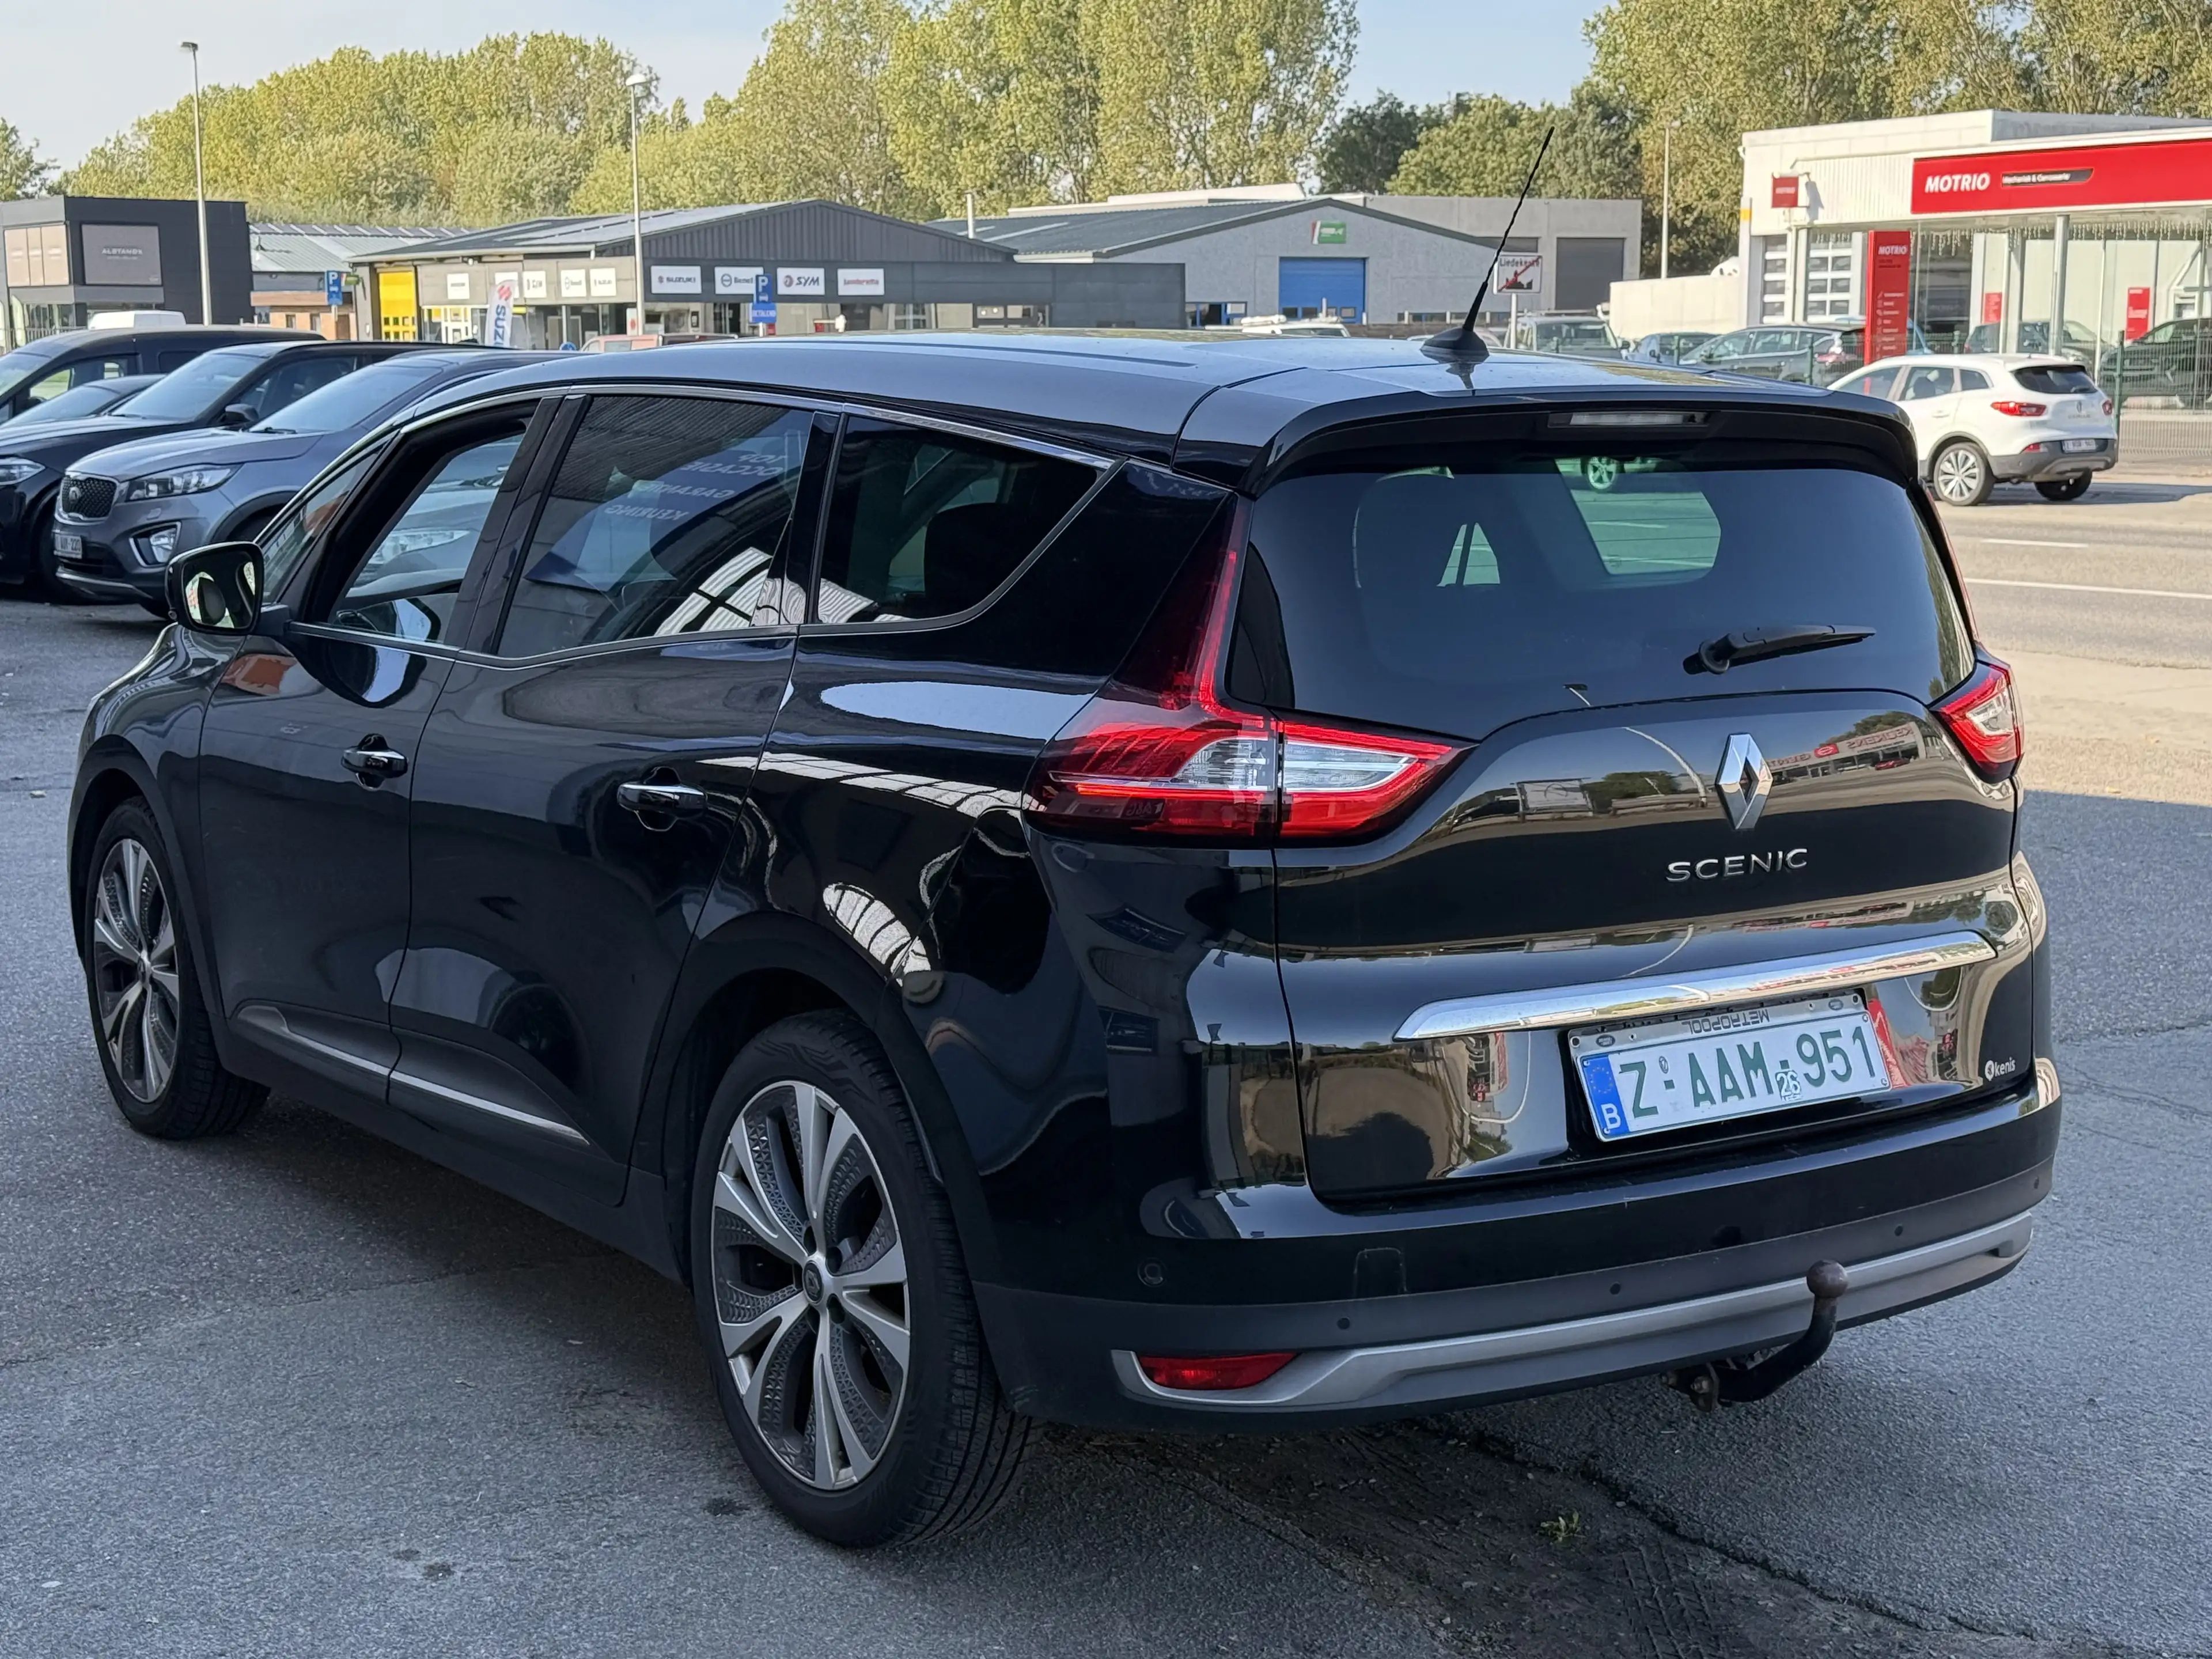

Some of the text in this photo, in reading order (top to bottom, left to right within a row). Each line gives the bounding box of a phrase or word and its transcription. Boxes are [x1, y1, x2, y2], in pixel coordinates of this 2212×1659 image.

[1925, 172, 1991, 193] MOTRIO
[1878, 245, 1907, 255] MOTRIO
[329, 272, 338, 285] P
[758, 276, 768, 293] P
[796, 276, 820, 287] SYM
[1665, 848, 1808, 882] SCENIC
[1681, 1008, 1771, 1036] METROPOOL
[1601, 1103, 1622, 1130] B
